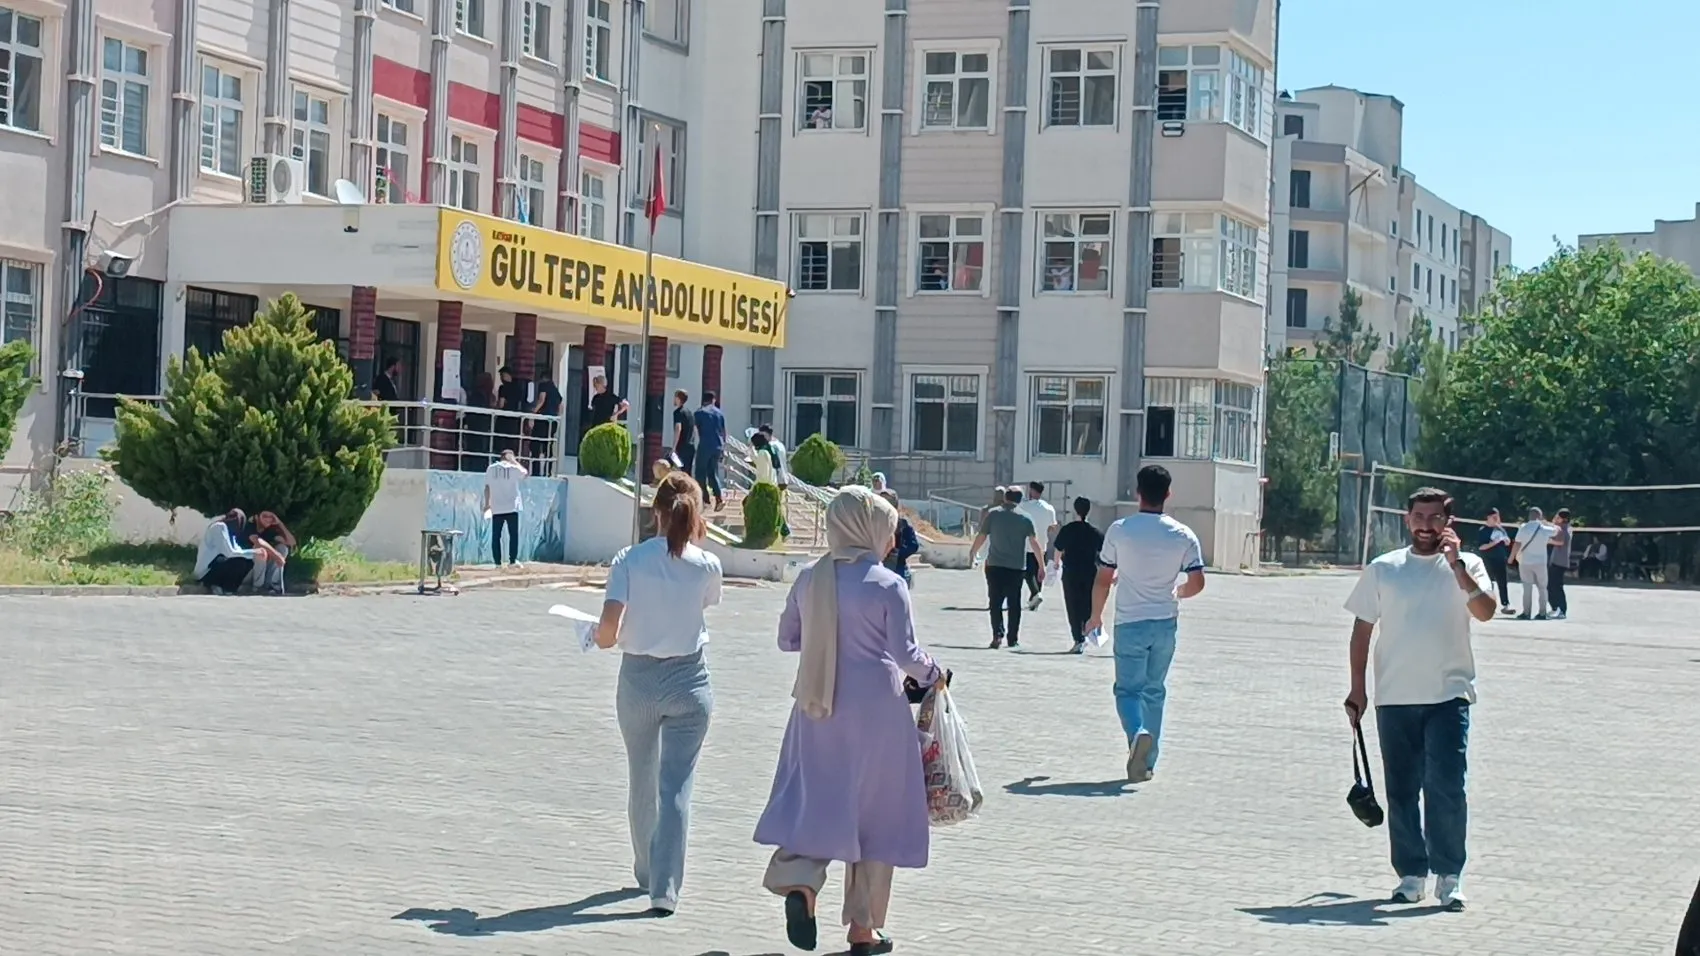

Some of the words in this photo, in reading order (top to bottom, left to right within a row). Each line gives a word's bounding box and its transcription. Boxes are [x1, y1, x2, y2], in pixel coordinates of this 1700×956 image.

[491, 234, 606, 306] GÜLTEPE
[611, 269, 714, 325] ANADOLU
[719, 282, 778, 337] LİSESİ
